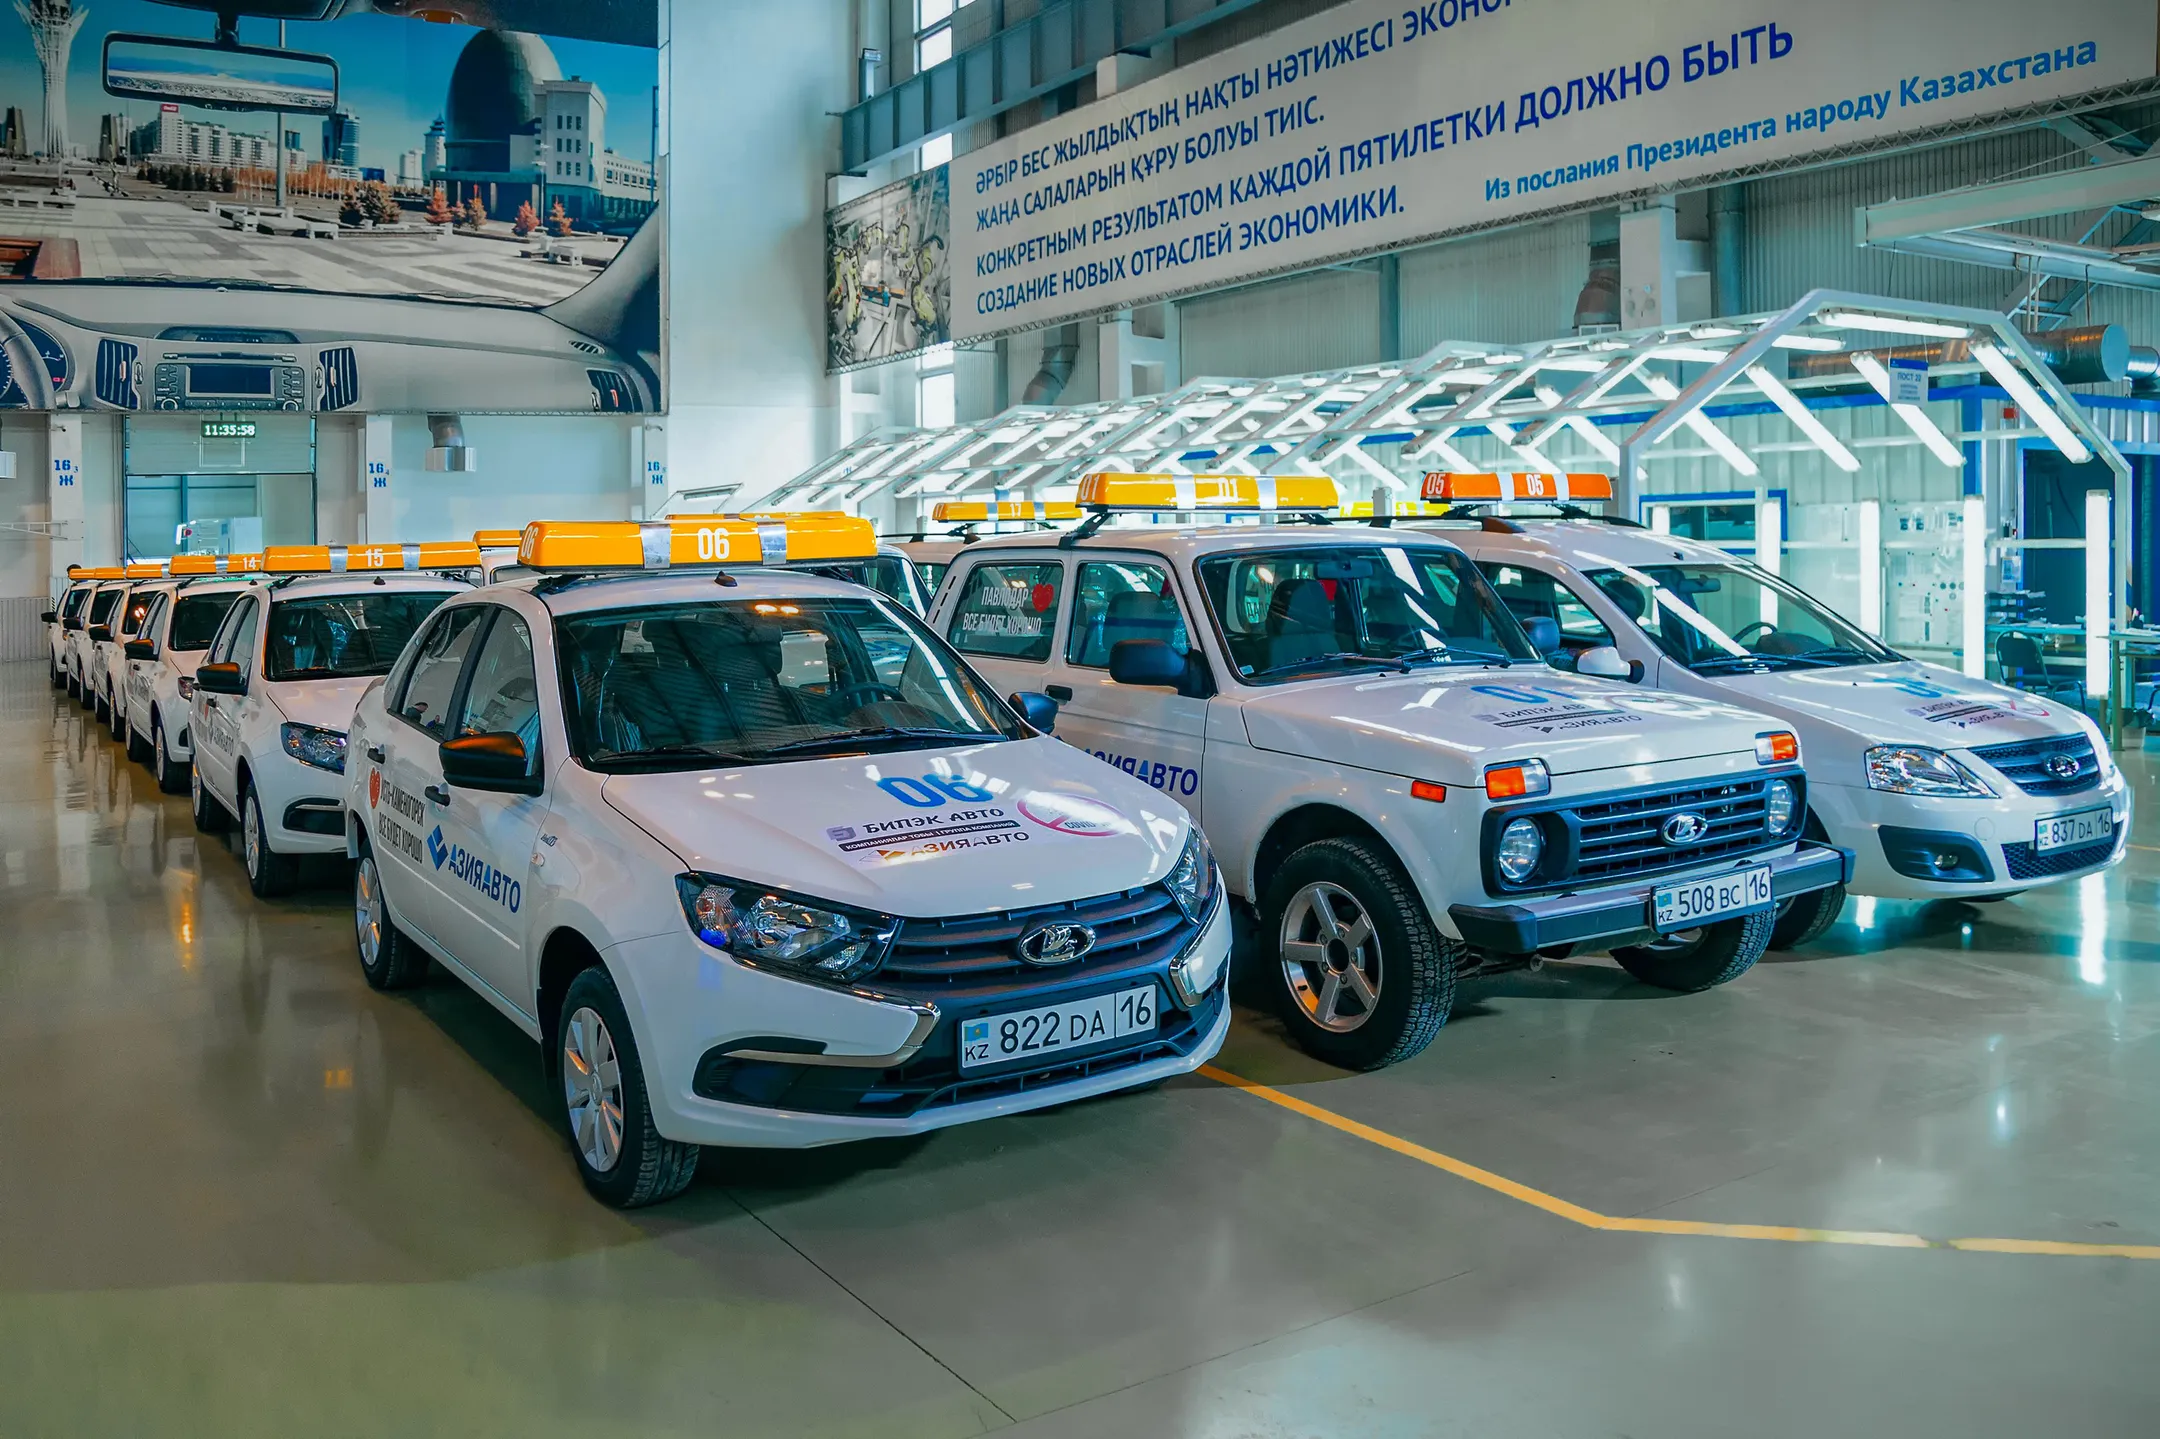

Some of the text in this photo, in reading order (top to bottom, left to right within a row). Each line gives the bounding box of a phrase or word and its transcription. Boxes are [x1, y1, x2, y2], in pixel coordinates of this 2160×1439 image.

[976, 0, 1511, 194] ӘРБІР БЕС ЖЫЛДЫҚТЫҢ НАҚТЫ НӘТИЖЕСІ ЭКОН
[1485, 40, 2097, 201] Из послания Президента народу Казахстана
[977, 22, 1793, 277] КОНКРЕТНЫМ РЕЗУЛЬТАТОМ КАЖДОЙ ПЯТИЛЕТКИ ДОЛЖНО БЫТЬ
[976, 95, 1325, 232] ЖАҢА САЛАЛАРЫН ҚҰРУ БОЛУЫ ТИІС.
[977, 185, 1404, 315] СОЗДАНИЕ НОВЫХ ОТРАСЛЕЙ ЭКОНОМИКИ.
[204, 424, 256, 436] 11:35:58
[54, 459, 71, 471] 16
[369, 463, 384, 474] 16
[647, 461, 660, 471] 16
[1080, 474, 1101, 501] 01
[1218, 477, 1239, 503] 01
[1426, 473, 1446, 495] 05
[1526, 473, 1545, 496] 05
[1010, 503, 1022, 518] 17
[521, 525, 539, 559] 06
[697, 527, 730, 560] 06
[243, 556, 257, 570] 14
[365, 548, 384, 567] 15
[981, 586, 1029, 608] ПАВЛОДАР
[962, 613, 1042, 635] ВСЕ БУДЕТ ХОРОШО
[1084, 748, 1199, 795] ЯАВТО
[876, 773, 994, 808] 06
[862, 808, 1005, 834] БИПЭК АВТО
[940, 827, 972, 836] ГРУППА
[2052, 818, 2075, 844] 837
[2078, 821, 2093, 839] DA
[2097, 812, 2111, 835] 16
[910, 831, 1030, 857] АЗИЯАВТО
[448, 843, 521, 914] АЗИЯАВТО
[1658, 872, 1768, 922] KZ 508 BC 16
[965, 991, 1151, 1061] KZ 822 DA 16
